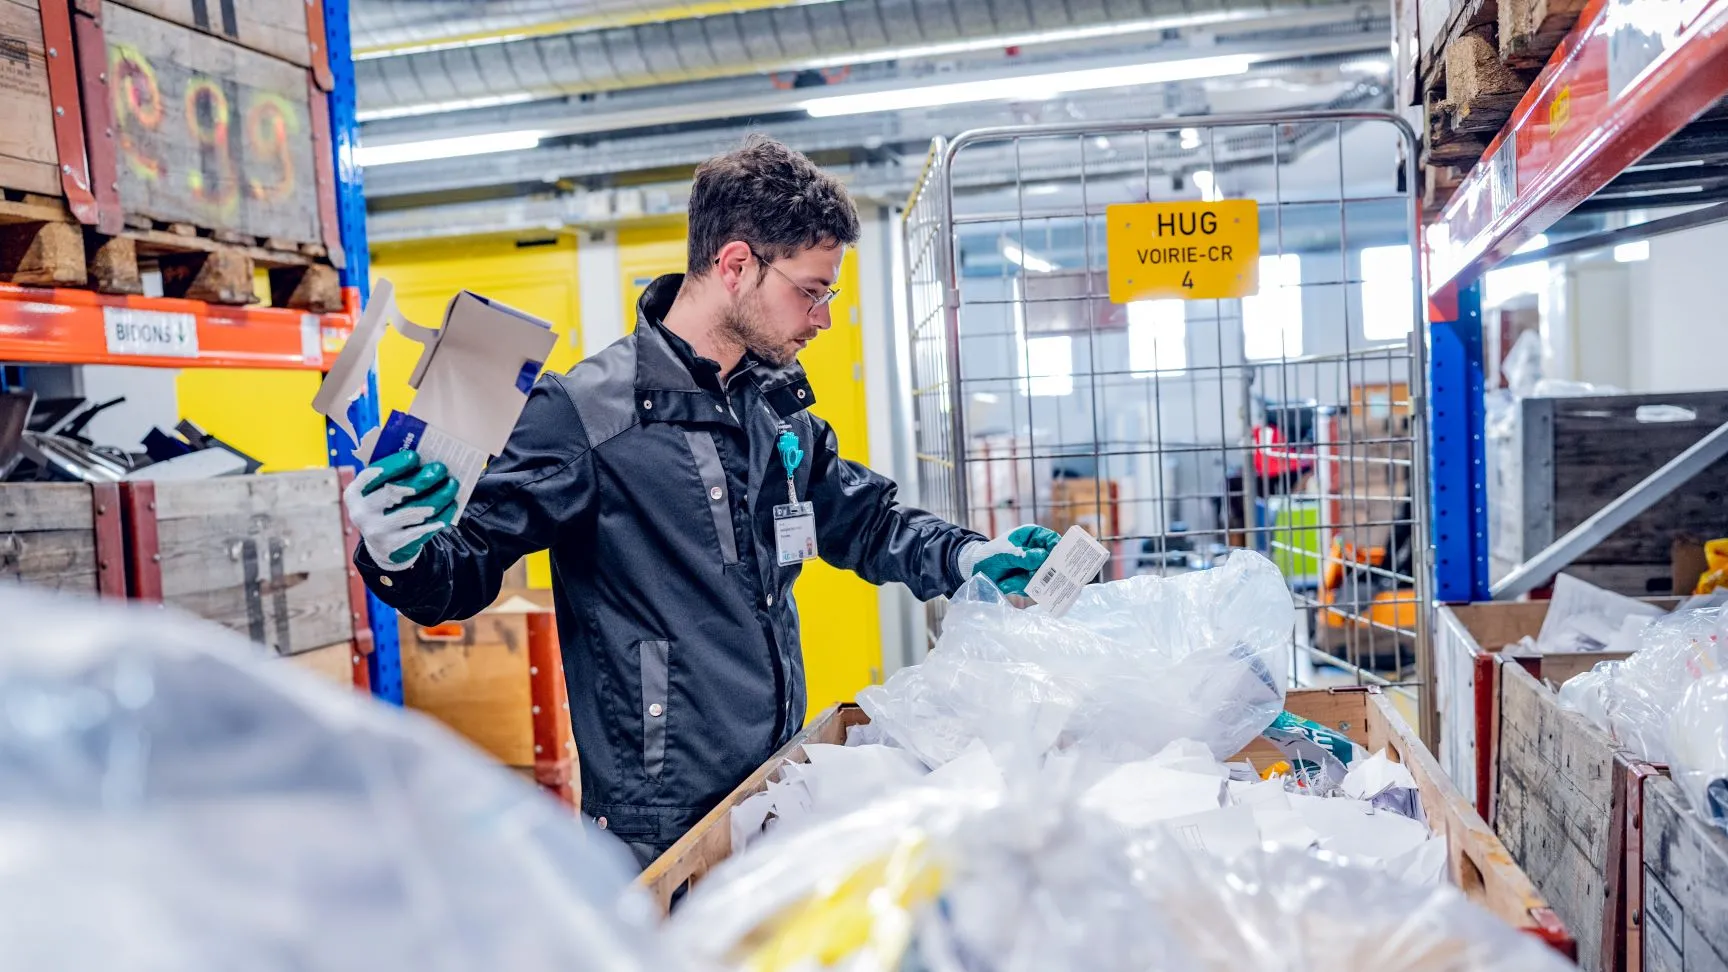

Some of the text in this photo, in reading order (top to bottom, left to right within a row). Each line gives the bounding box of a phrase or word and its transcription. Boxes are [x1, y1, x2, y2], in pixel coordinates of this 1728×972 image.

[1158, 211, 1217, 237] HUG
[1137, 245, 1233, 264] VOIRIE-CR
[1182, 271, 1194, 289] 4
[115, 323, 171, 343] BIDONS
